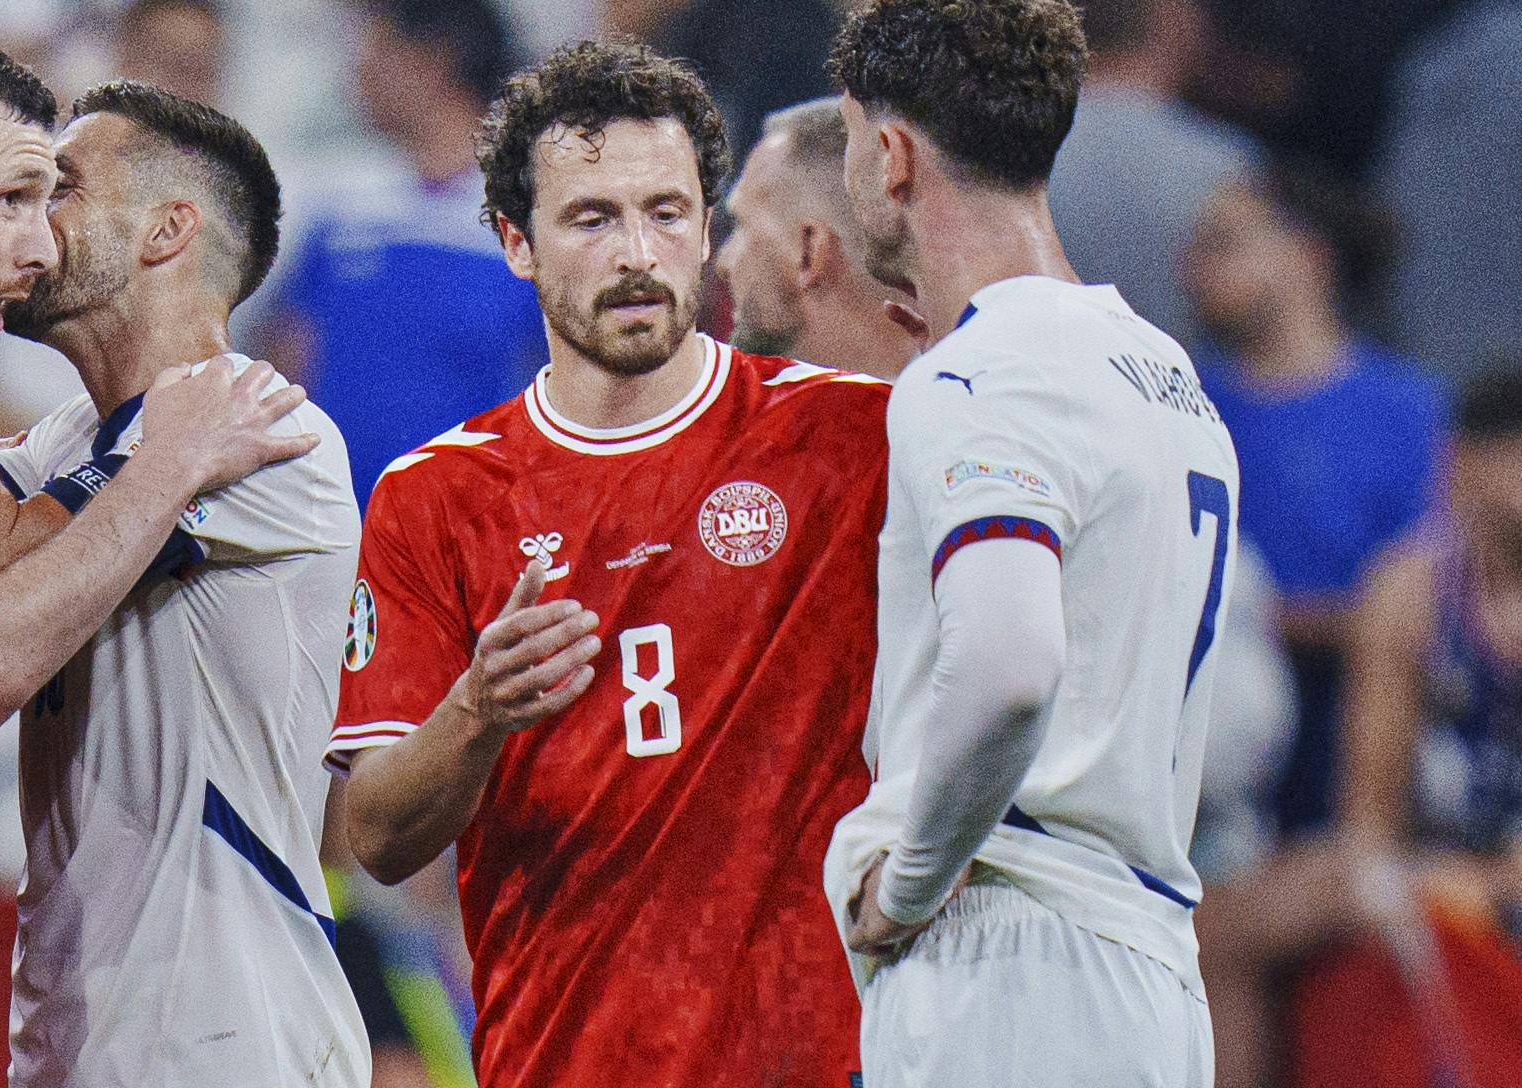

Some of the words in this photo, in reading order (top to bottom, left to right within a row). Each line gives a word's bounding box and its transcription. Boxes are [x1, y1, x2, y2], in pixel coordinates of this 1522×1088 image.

[717, 507, 769, 536] DBU
[1186, 469, 1230, 704] 7
[621, 622, 682, 757] 8
